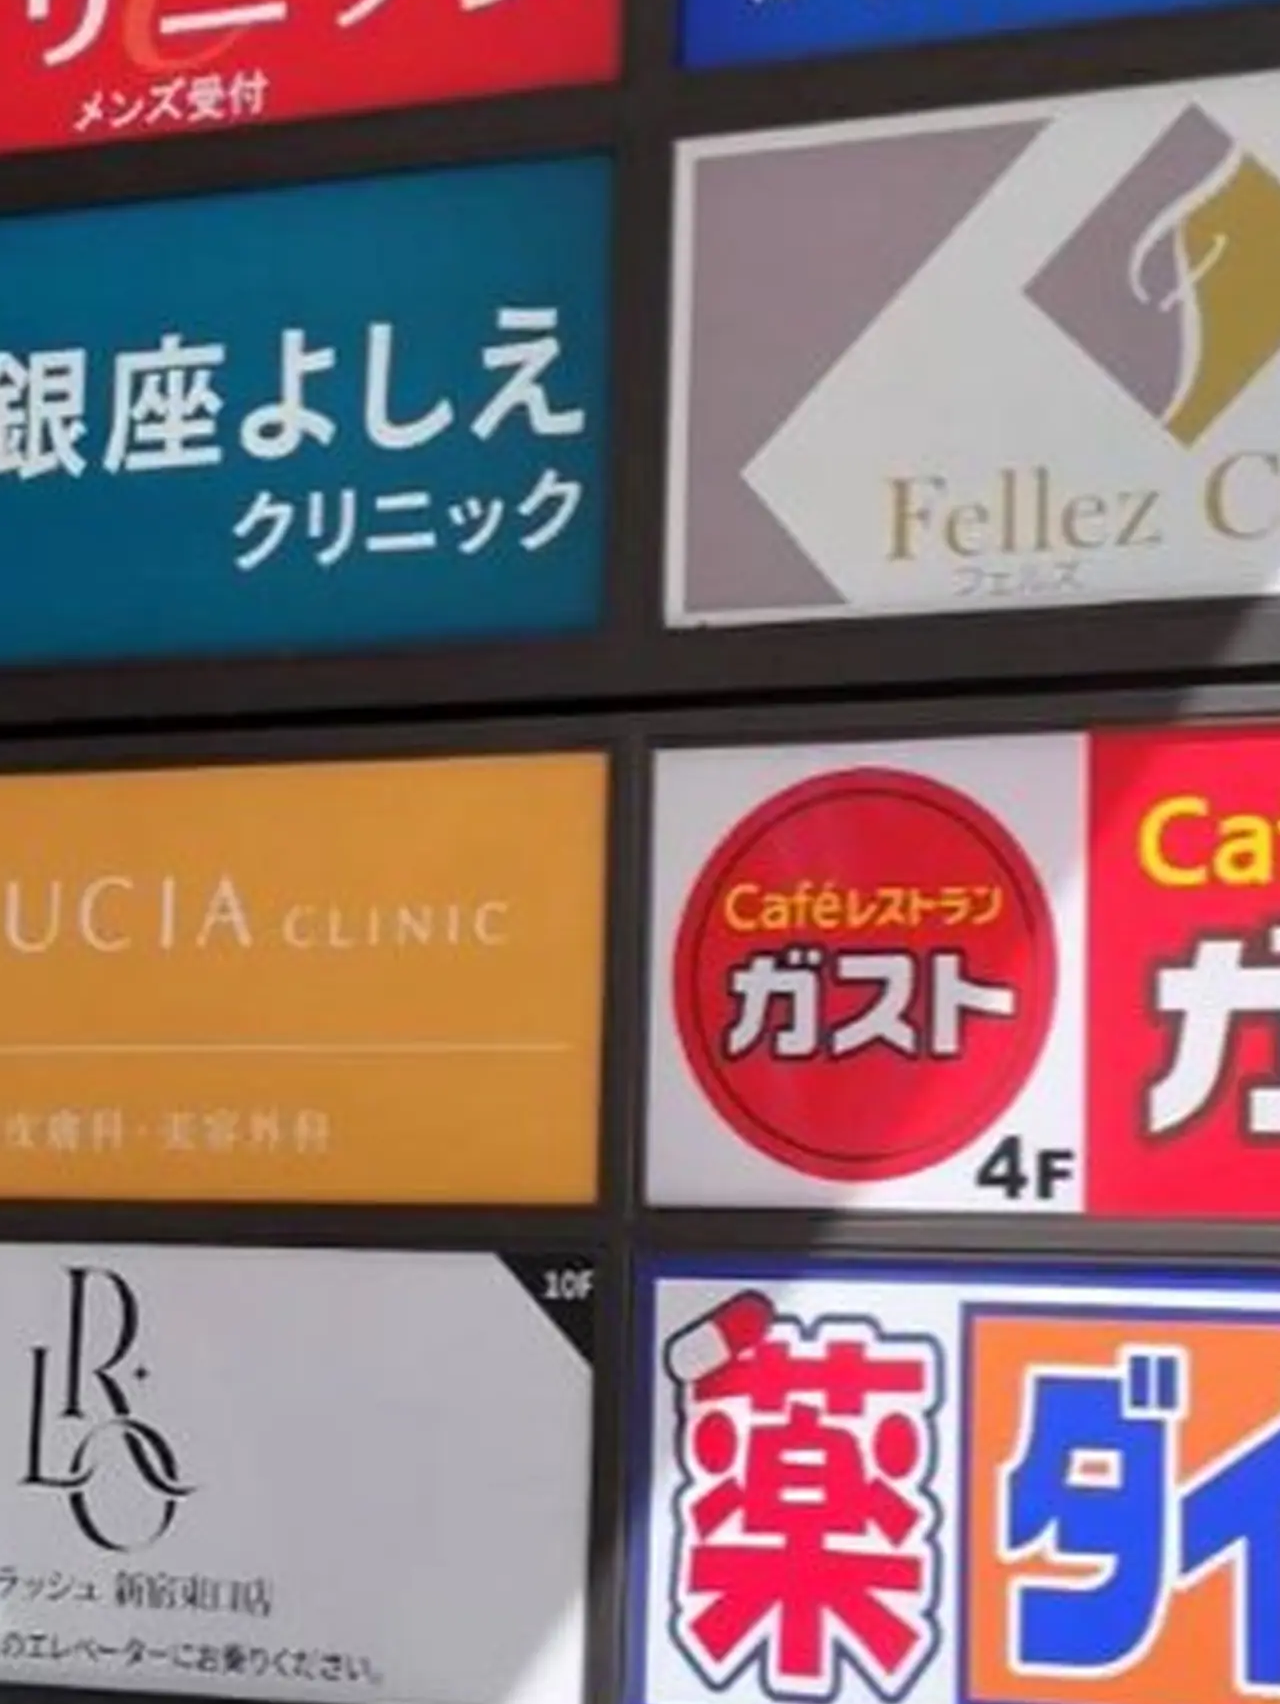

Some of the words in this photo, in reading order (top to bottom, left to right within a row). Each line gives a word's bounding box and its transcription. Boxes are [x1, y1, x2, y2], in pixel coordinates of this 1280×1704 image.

[74, 70, 268, 132] メンズ受付
[233, 470, 582, 570] クリニック
[886, 465, 1162, 562] Fellez
[282, 901, 509, 950] CLINIC
[727, 947, 1018, 1058] ガスト
[974, 1136, 1076, 1200] 4F
[542, 1268, 594, 1300] 10F
[685, 1305, 930, 1690] 薬
